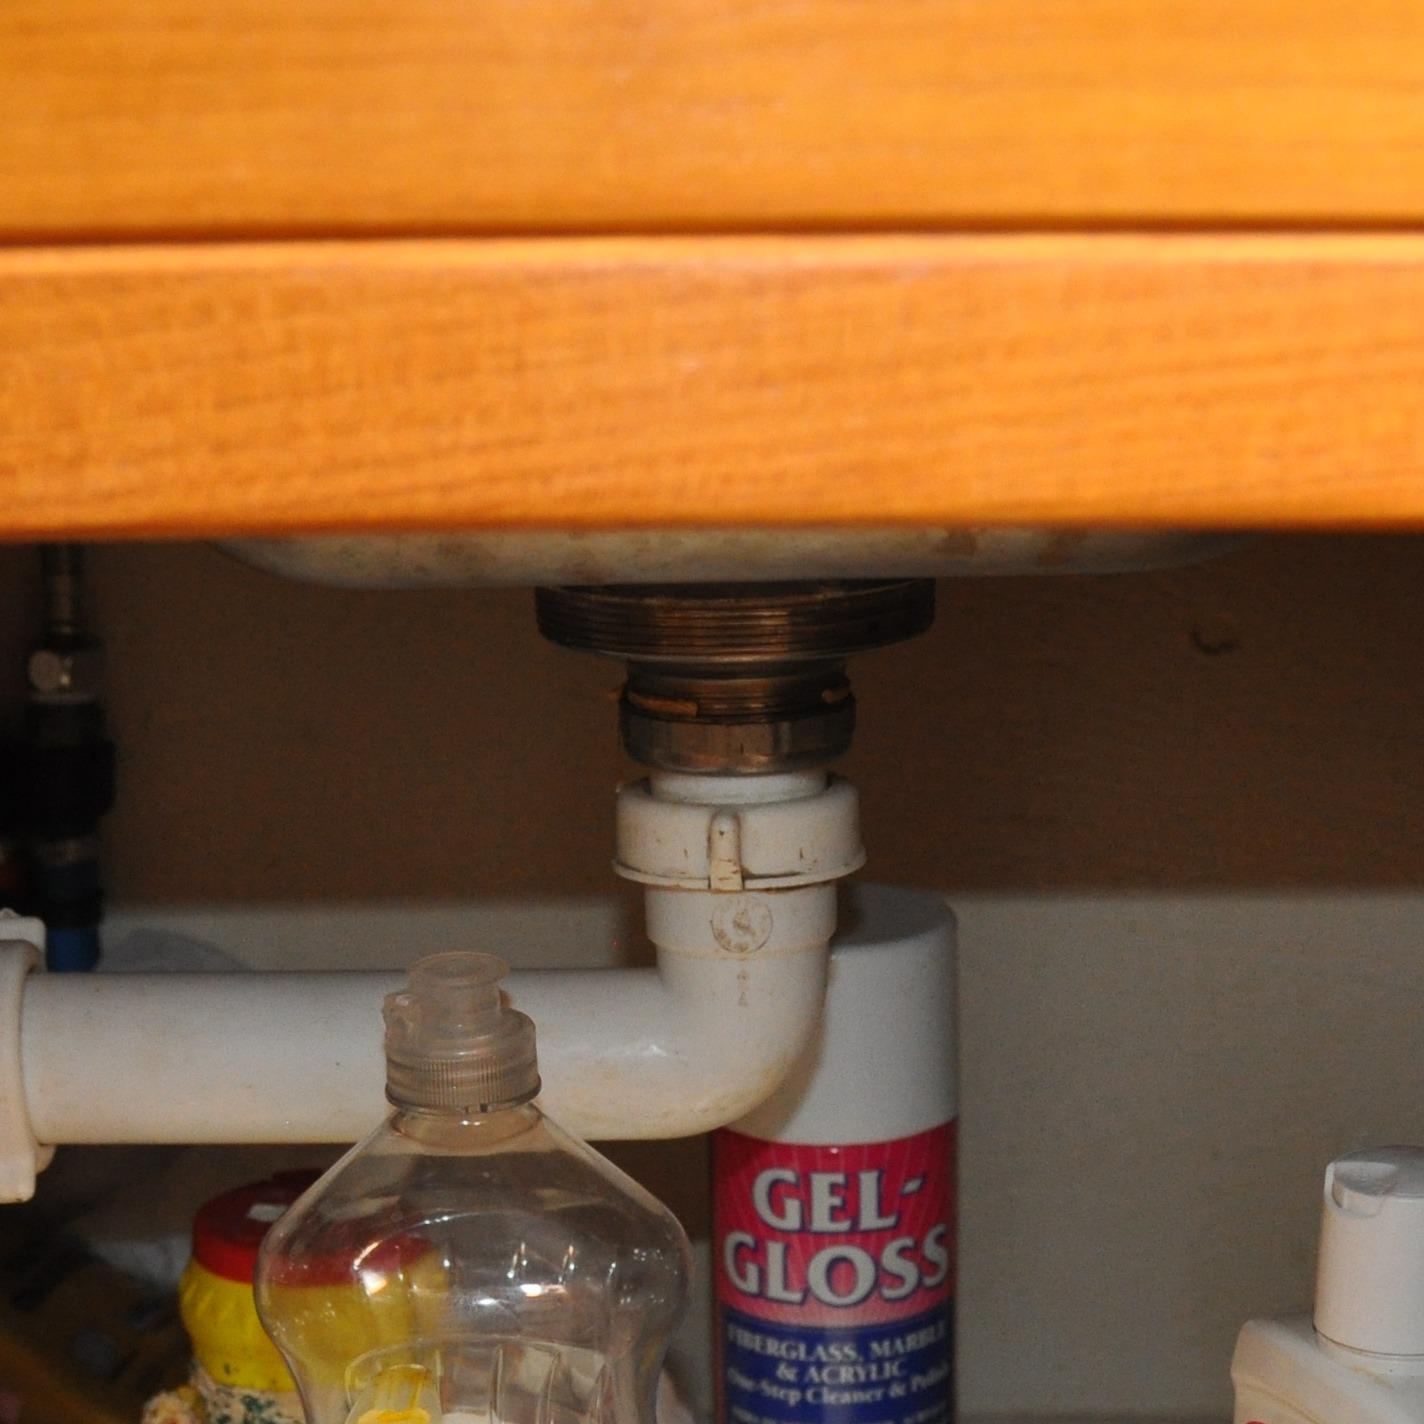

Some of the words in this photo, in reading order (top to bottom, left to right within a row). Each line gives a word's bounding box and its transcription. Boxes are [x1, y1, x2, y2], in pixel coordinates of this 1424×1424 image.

[753, 1167, 924, 1232] GEL-
[724, 1223, 949, 1306] GLOSS
[805, 1358, 907, 1384] ACRYLIC
